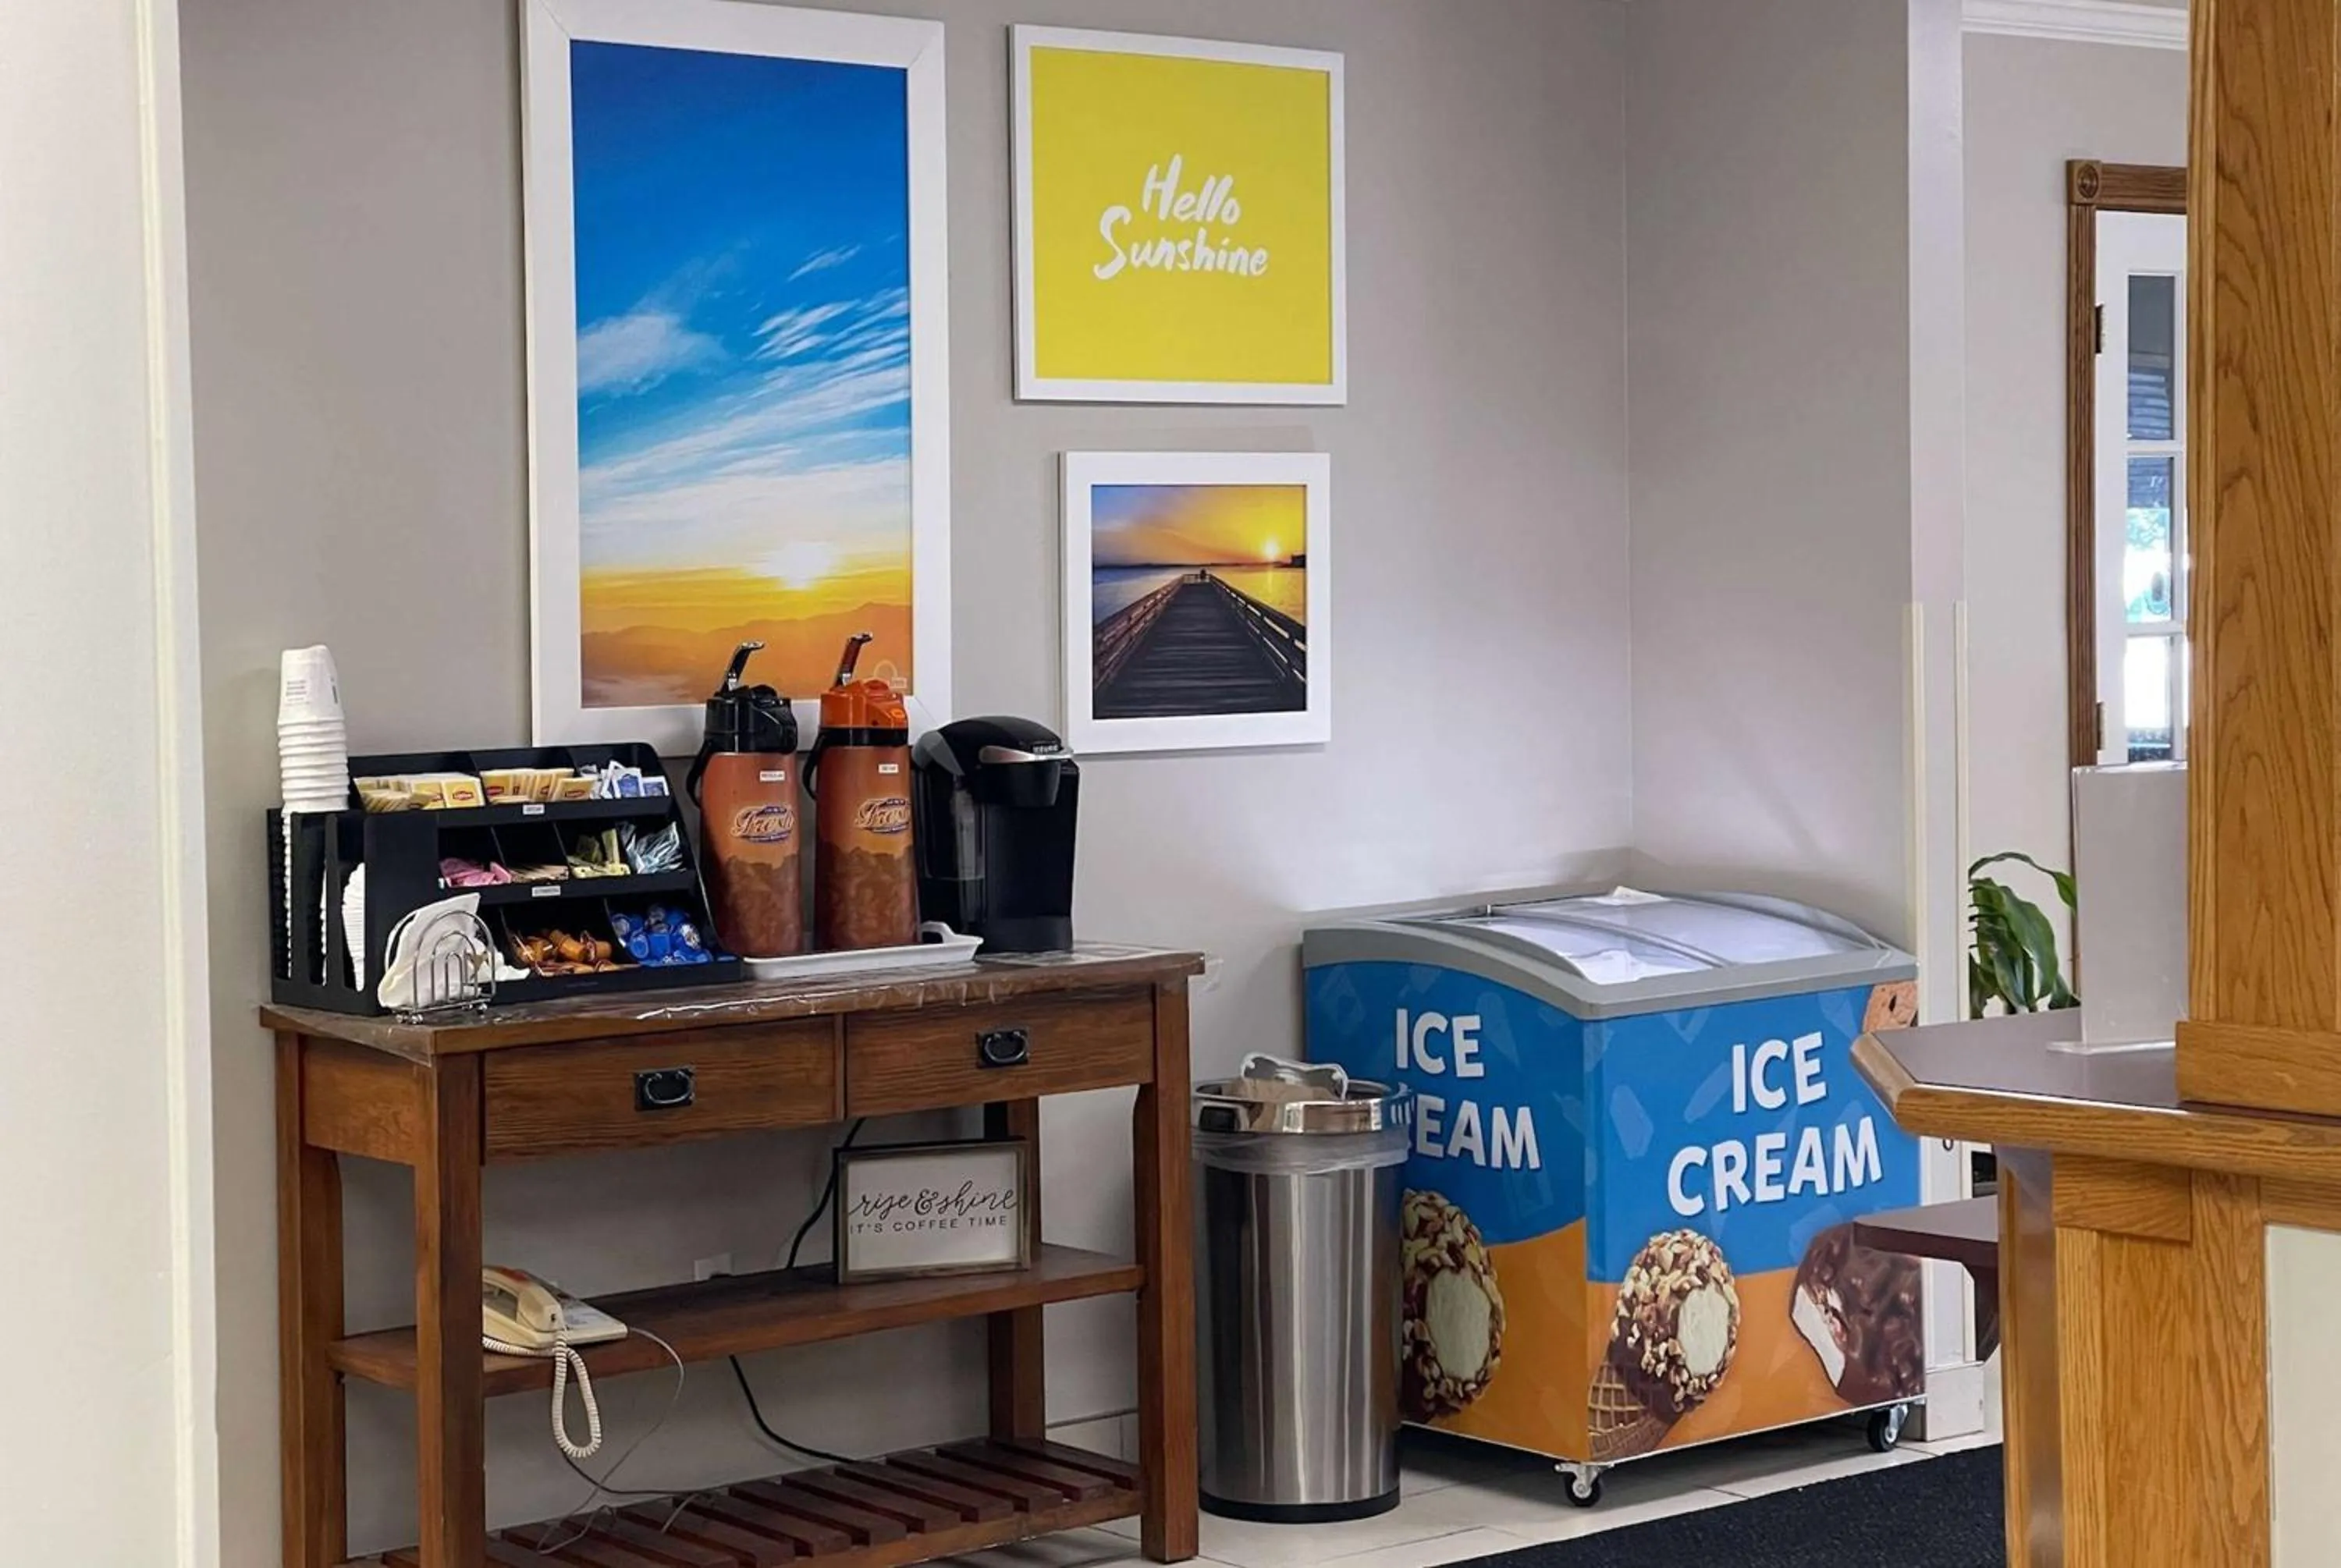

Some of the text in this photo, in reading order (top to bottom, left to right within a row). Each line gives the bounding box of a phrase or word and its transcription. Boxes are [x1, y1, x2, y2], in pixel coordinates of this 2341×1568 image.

[1142, 153, 1241, 225] Hello
[1092, 204, 1269, 280] Sunshine
[1396, 1008, 1484, 1078] ICE
[1732, 1031, 1827, 1113] ICE
[1416, 1093, 1541, 1170] EAM
[1667, 1116, 1883, 1216] CREAM
[850, 1215, 1007, 1235] IT'S COFFEE TIME
